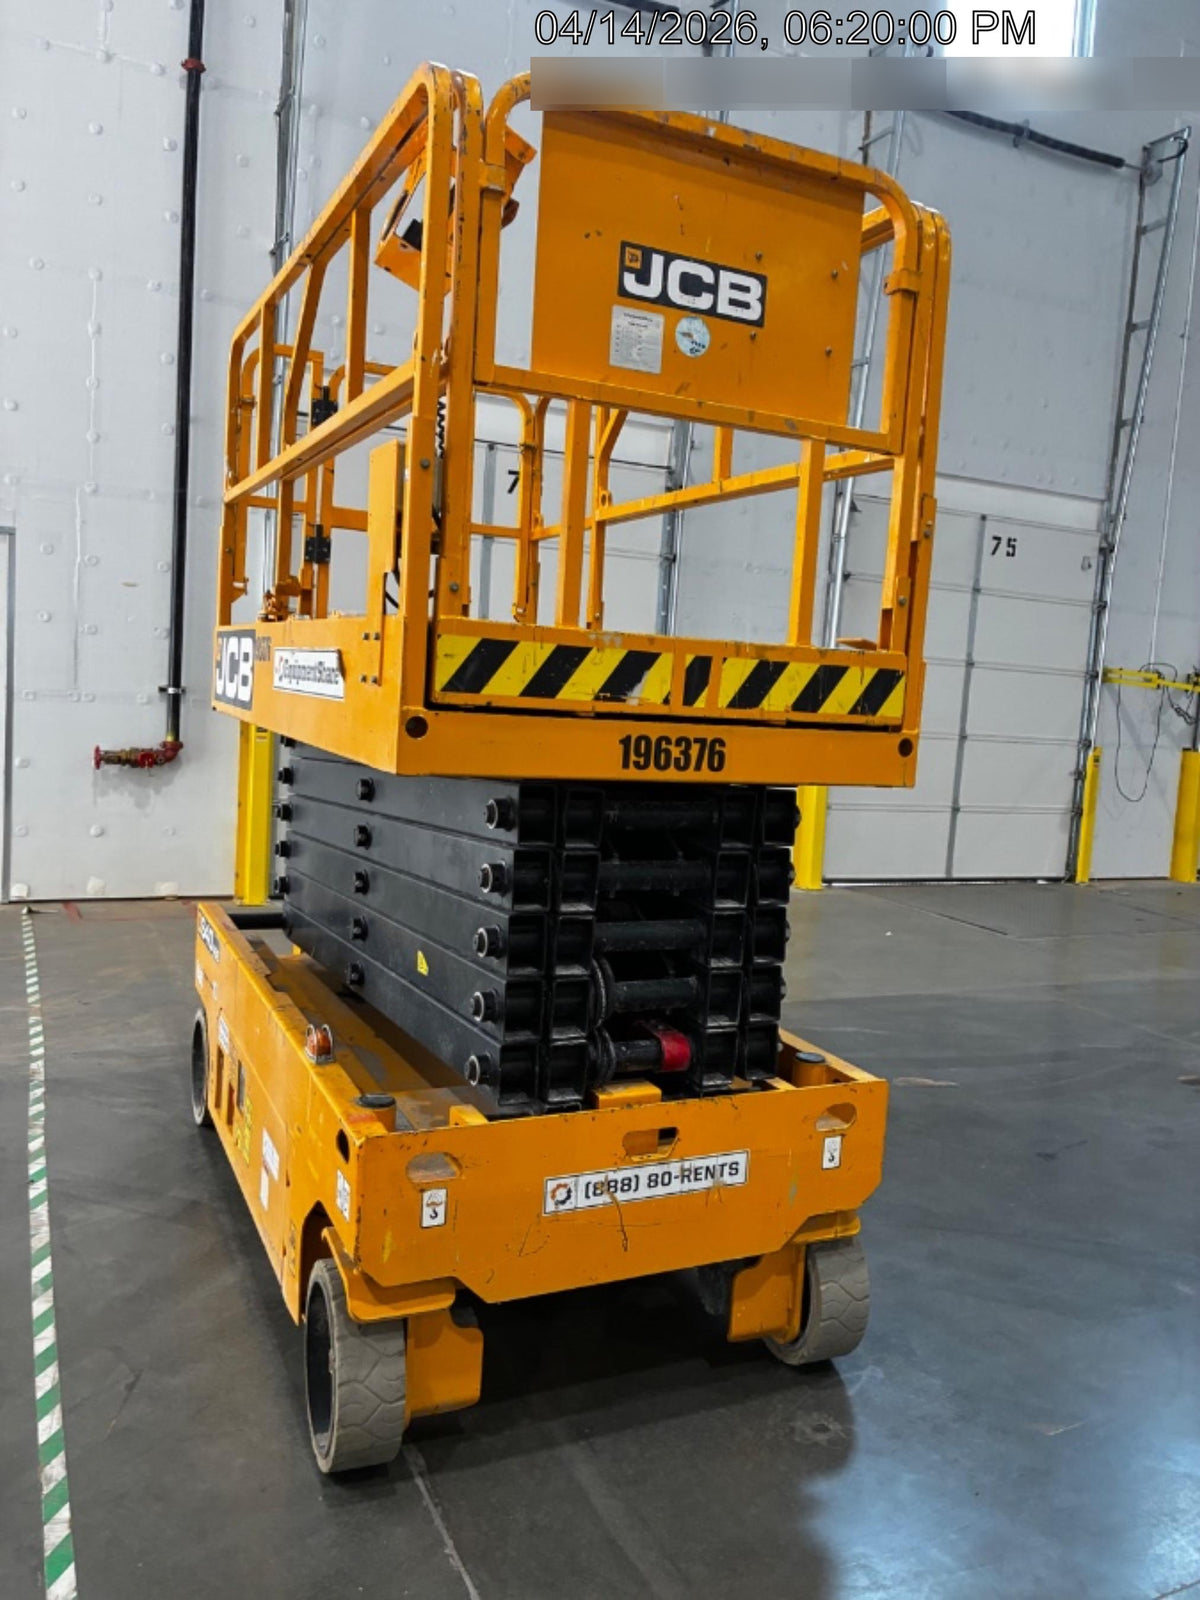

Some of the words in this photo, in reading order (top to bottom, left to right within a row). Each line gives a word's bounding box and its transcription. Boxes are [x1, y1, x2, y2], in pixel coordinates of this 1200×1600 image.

[623, 253, 763, 321] JCB
[991, 535, 1018, 557] 75
[216, 636, 253, 702] JCB
[619, 734, 726, 772] 196376
[584, 1173, 640, 1199] (888)
[646, 1161, 740, 1189] 80-RENTS
